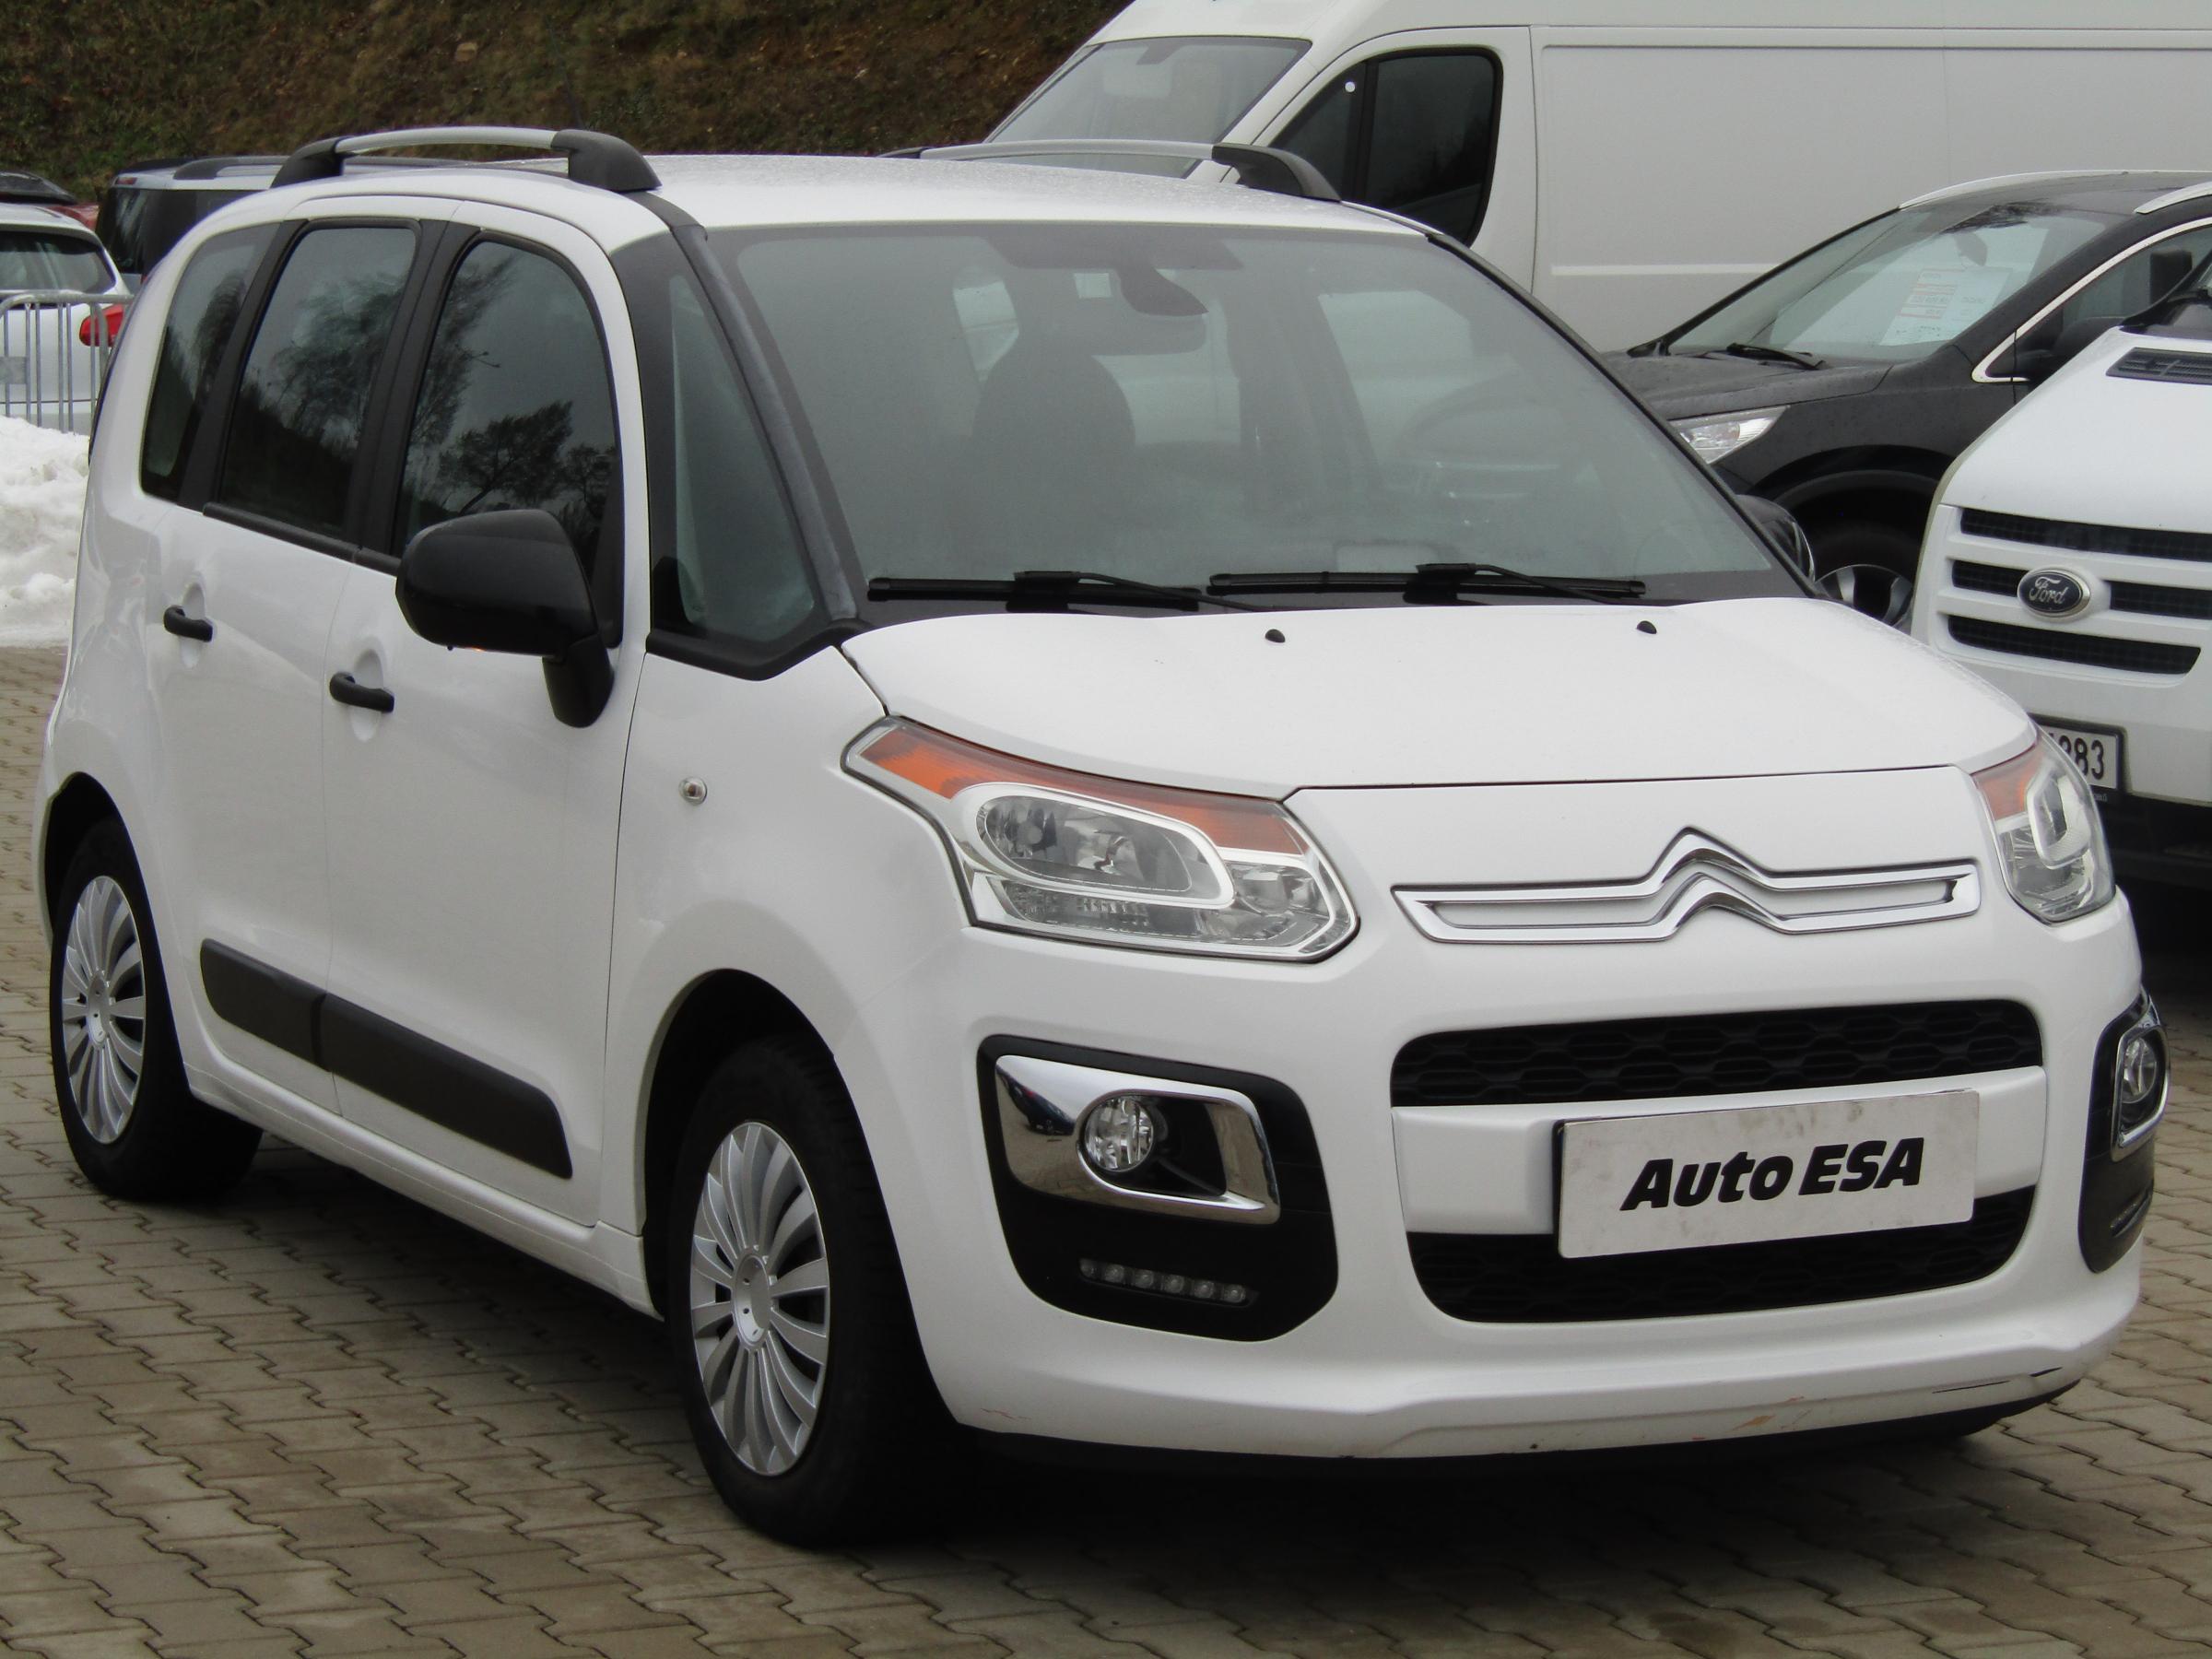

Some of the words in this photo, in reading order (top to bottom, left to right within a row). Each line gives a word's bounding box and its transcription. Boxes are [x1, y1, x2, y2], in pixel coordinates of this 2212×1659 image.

[2029, 576, 2069, 605] Ford
[1619, 1151, 1794, 1211] Auto
[1798, 1136, 1924, 1196] ESA
